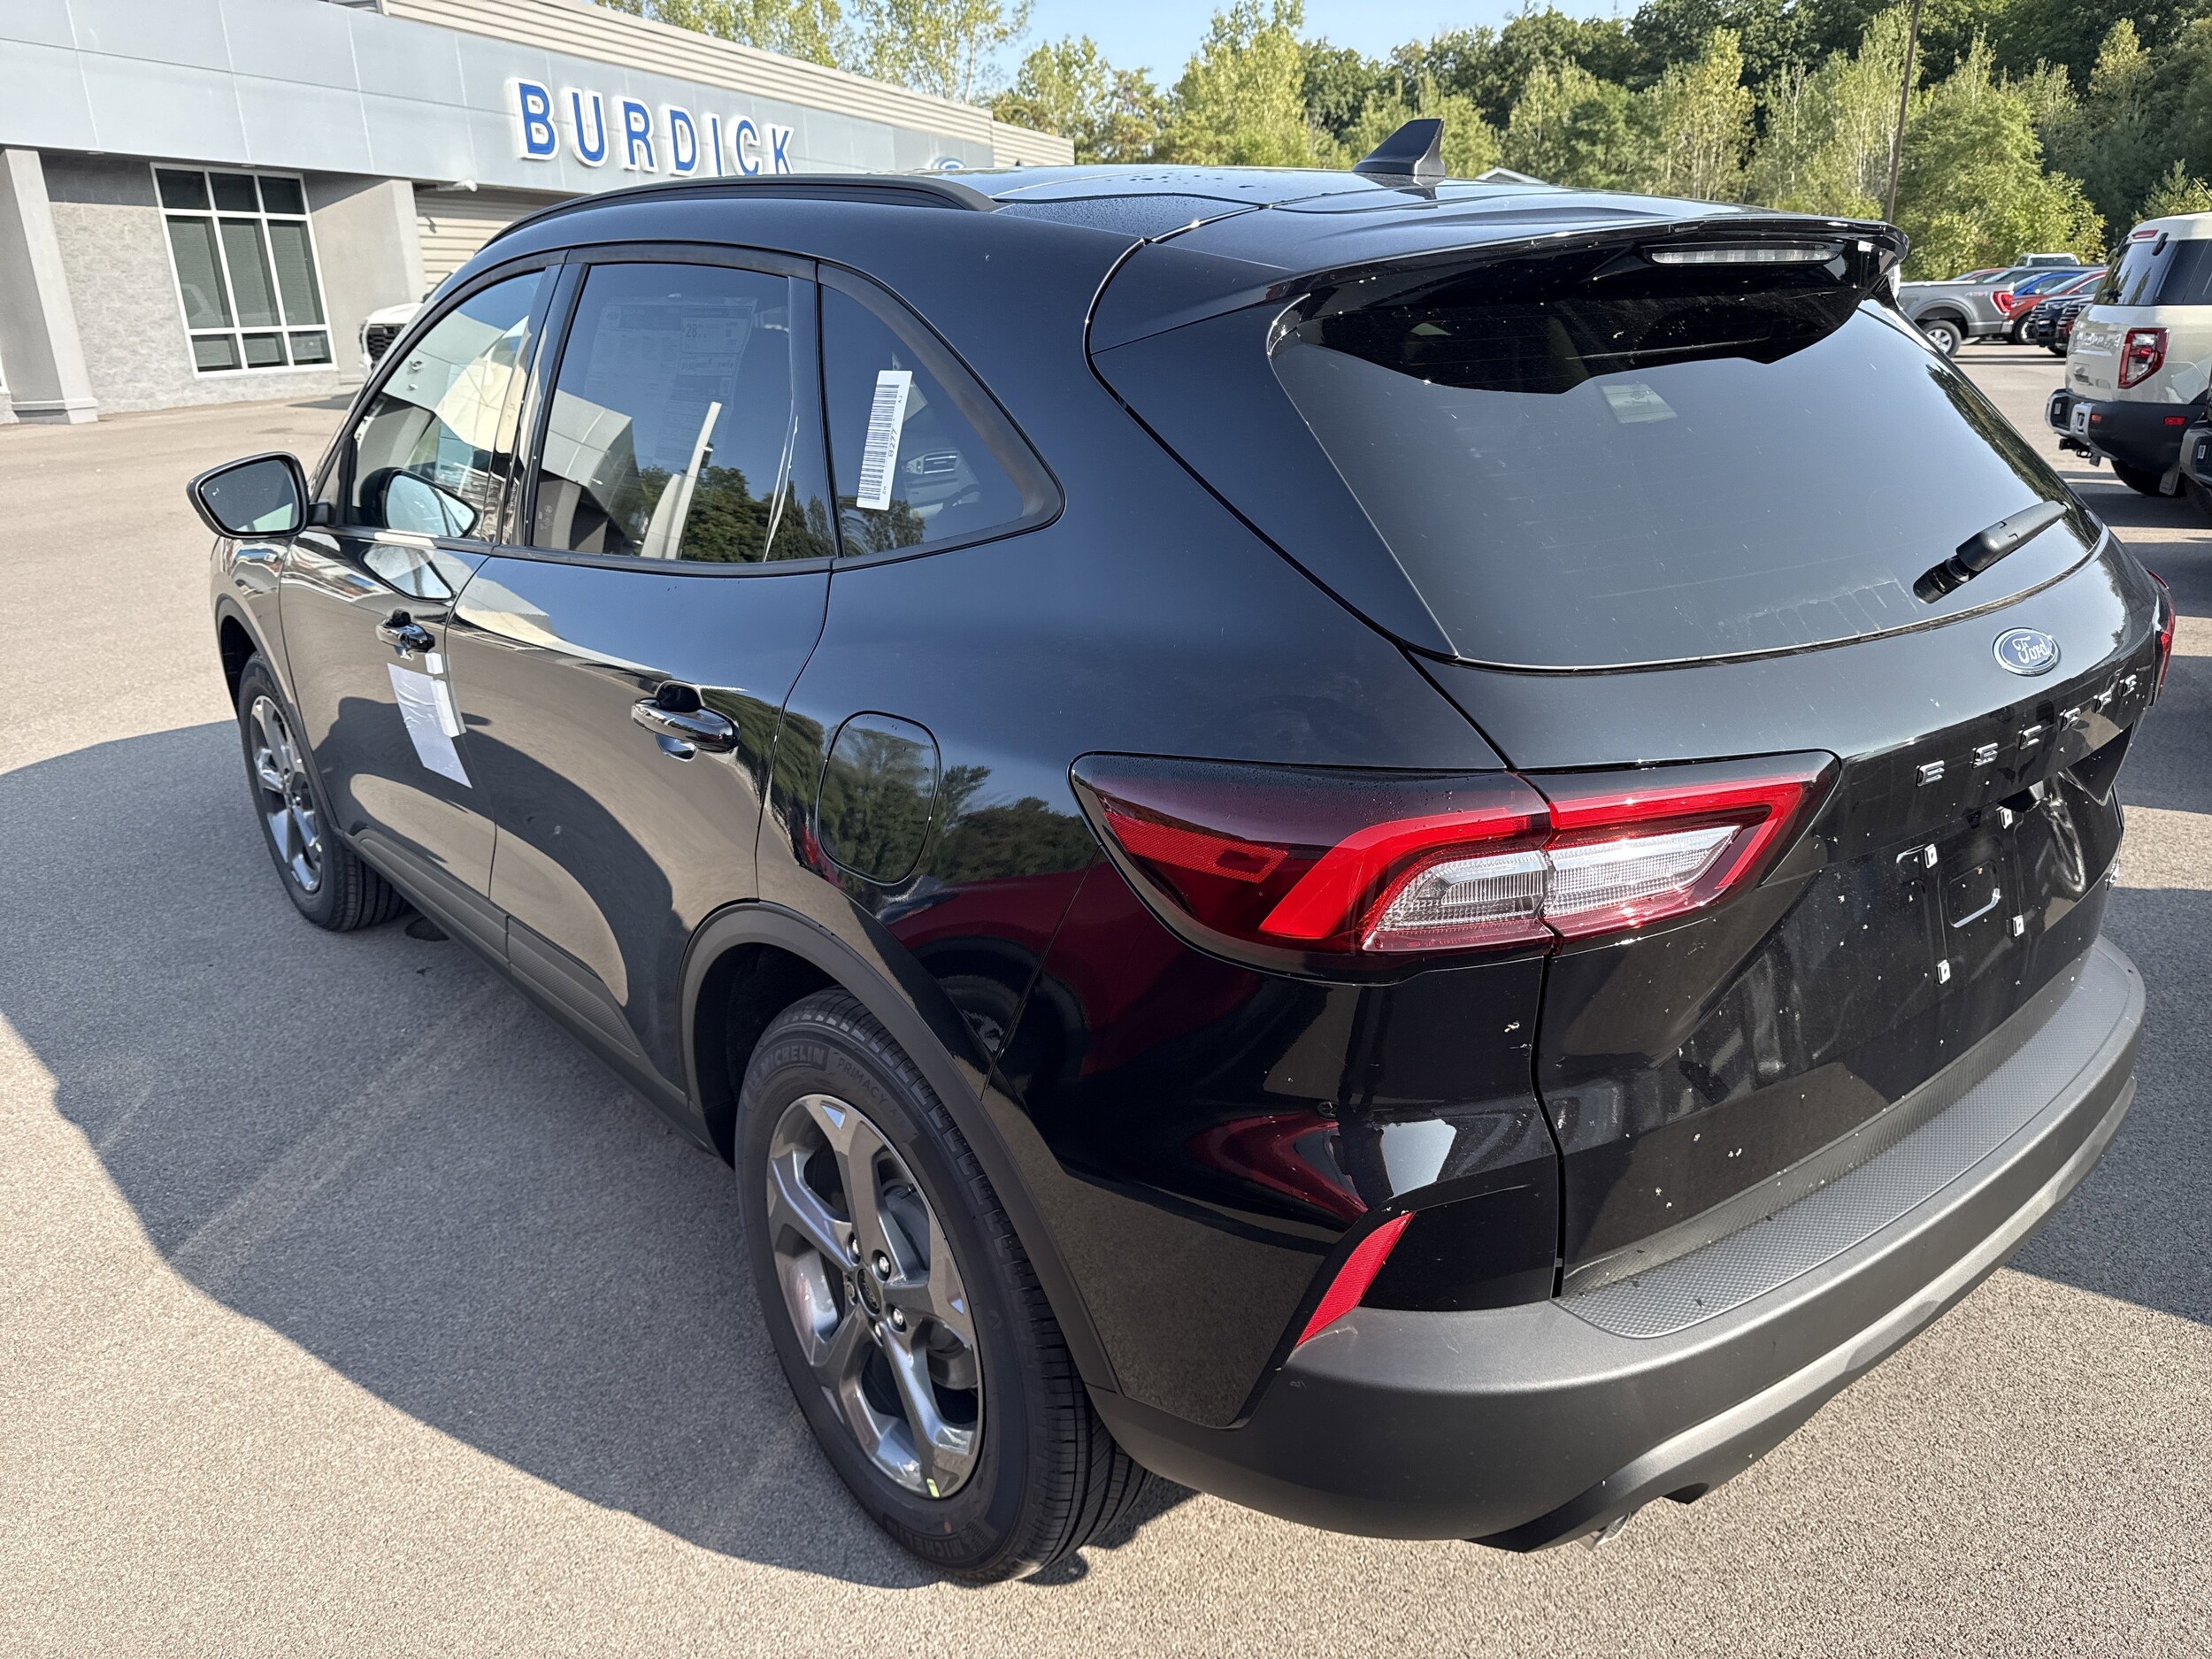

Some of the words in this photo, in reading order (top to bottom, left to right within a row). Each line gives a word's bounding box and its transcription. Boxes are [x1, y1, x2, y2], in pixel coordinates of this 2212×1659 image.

[511, 78, 795, 175] BURDICK
[887, 428, 898, 457] 8277
[2011, 635, 2053, 664] Ford
[760, 1044, 825, 1077] MICHELIN
[836, 1056, 890, 1106] PRIMACY
